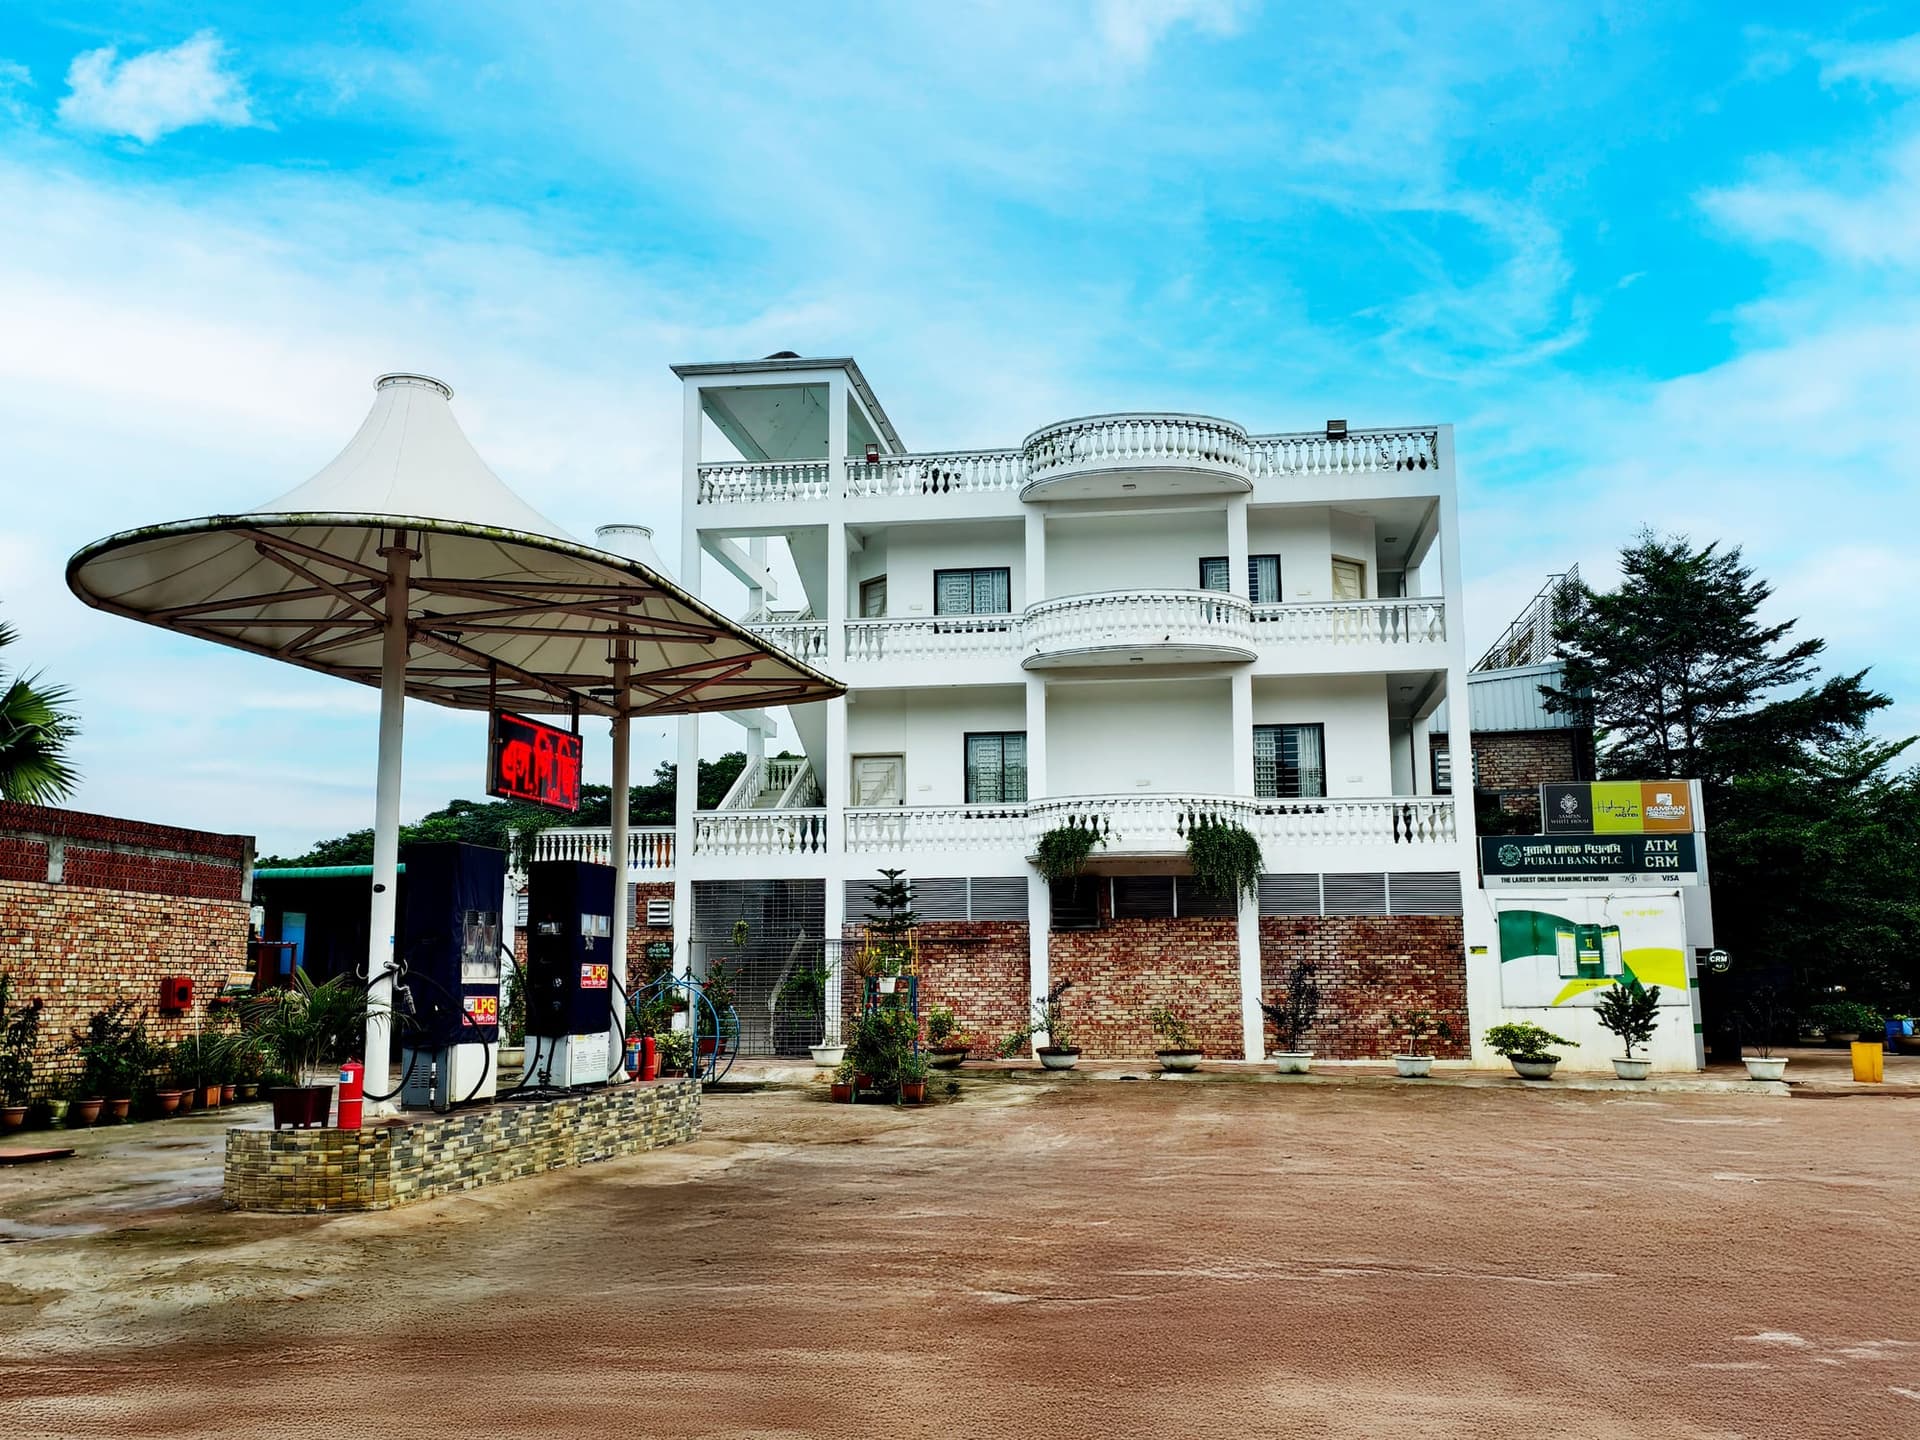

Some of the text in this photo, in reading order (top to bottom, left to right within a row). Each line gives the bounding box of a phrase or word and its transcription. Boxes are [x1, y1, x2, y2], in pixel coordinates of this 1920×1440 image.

[1644, 840, 1678, 851] ATM
[1524, 856, 1564, 865] PUBALI
[1567, 856, 1598, 865] BANK
[1645, 856, 1679, 868] CRM
[1662, 874, 1680, 882] VISA
[591, 966, 607, 980] LPG
[474, 998, 495, 1014] LPG
